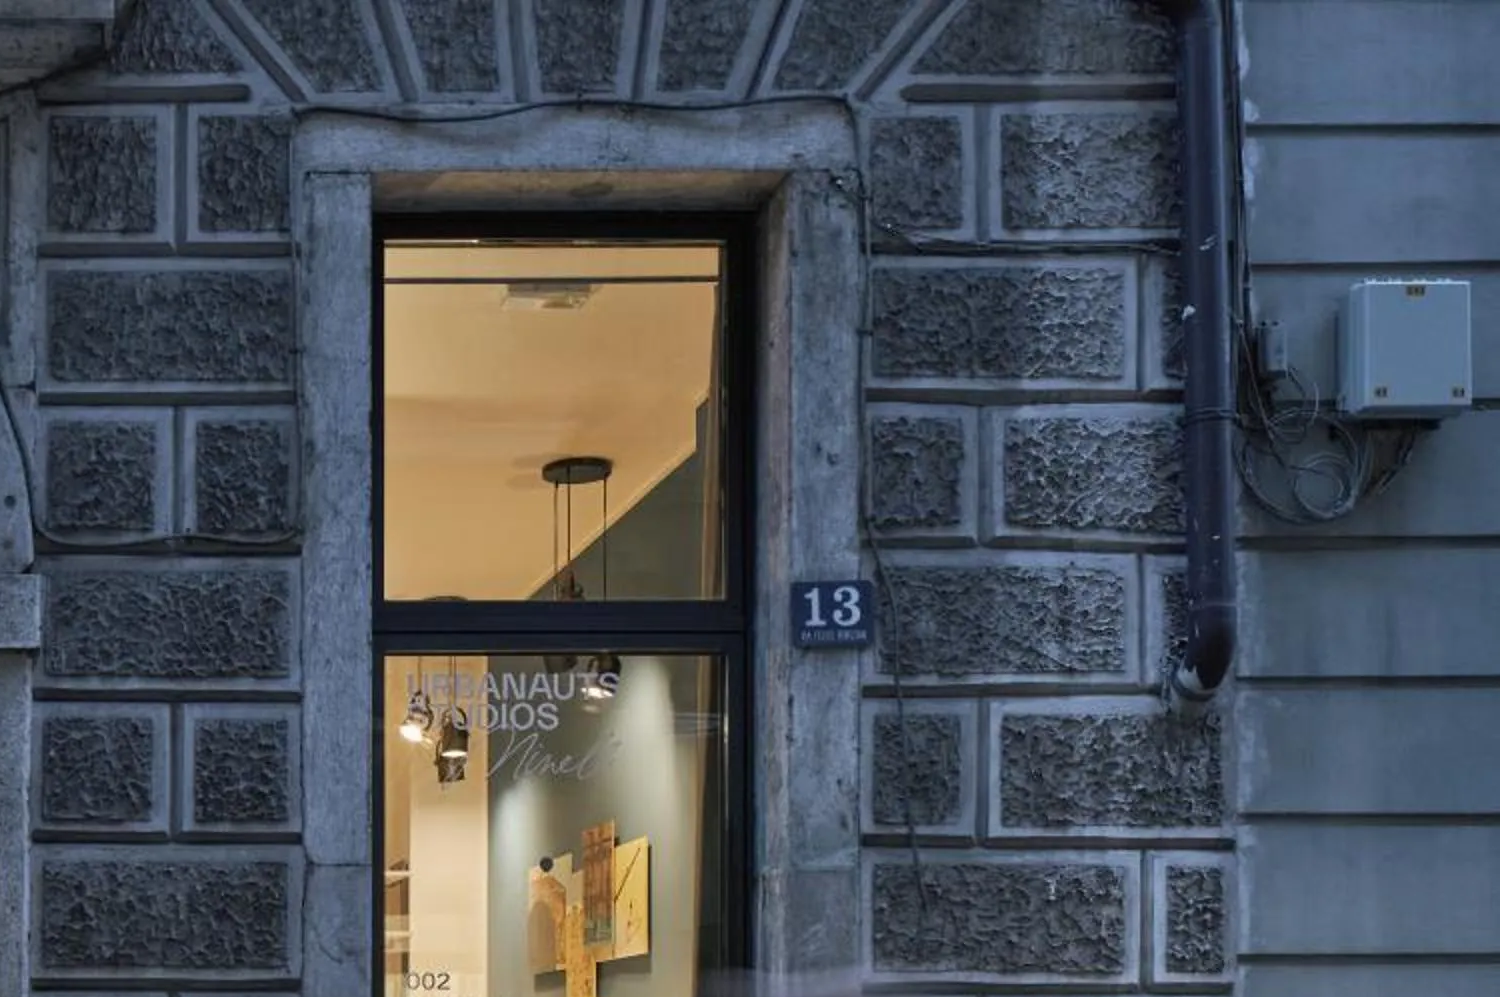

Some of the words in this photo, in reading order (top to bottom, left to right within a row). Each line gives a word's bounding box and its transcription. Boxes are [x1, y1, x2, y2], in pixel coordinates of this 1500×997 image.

[803, 585, 861, 626] 13
[406, 672, 620, 701] URBANAUTS
[407, 972, 451, 991] 002
